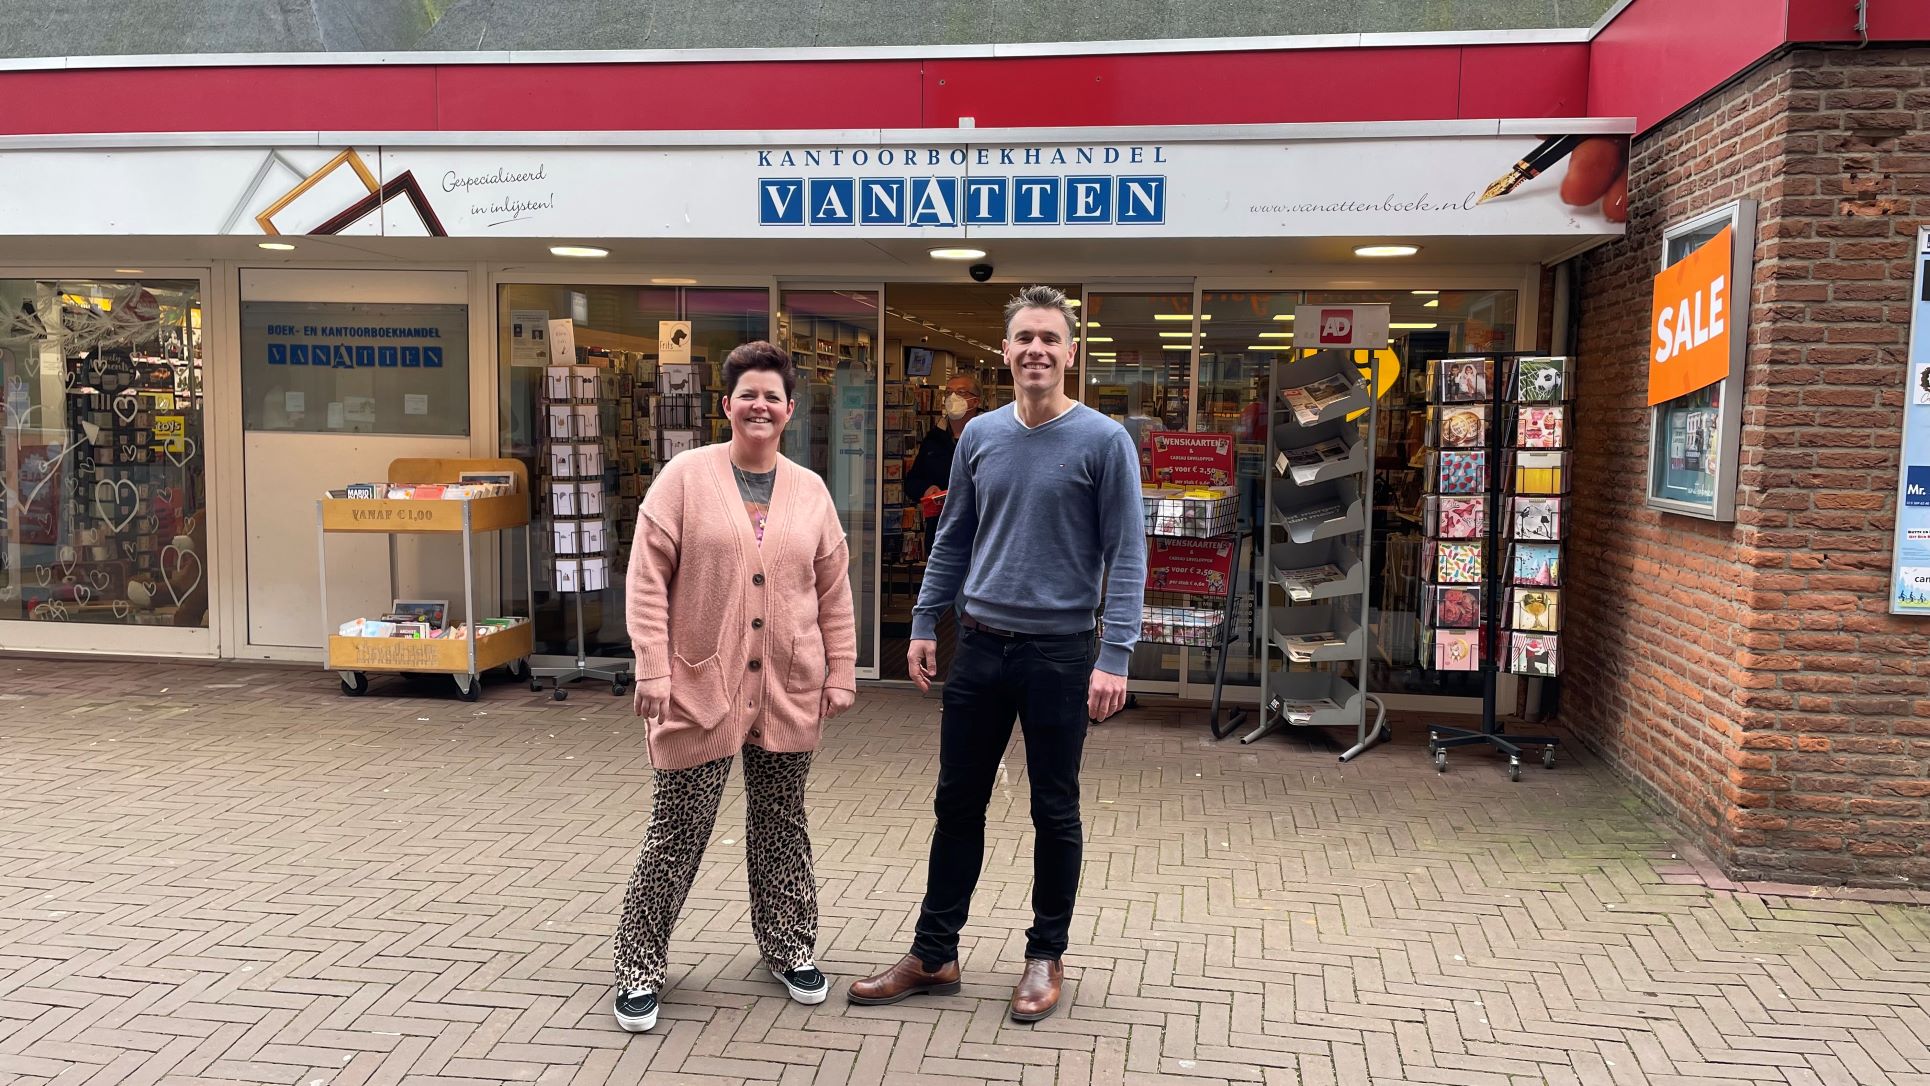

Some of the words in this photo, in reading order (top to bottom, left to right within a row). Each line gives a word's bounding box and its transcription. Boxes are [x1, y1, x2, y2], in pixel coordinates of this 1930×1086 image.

[757, 146, 1167, 167] KANTOORBOEKHANDEL
[441, 163, 547, 193] Gespecialiseerd
[471, 204, 487, 215] in
[490, 192, 554, 219] inlijsten!
[1250, 191, 1476, 213] www.vanattenboek.nl
[1321, 317, 1351, 337] AD
[1655, 275, 1725, 363] SALE
[267, 325, 300, 336] BOEK-
[303, 326, 318, 337] EN
[321, 326, 441, 338] KANTOORBOEKHANDEL
[1162, 437, 1221, 447] WENSKAARTEN
[1906, 484, 1927, 496] Mr.
[351, 509, 393, 522] VANAF
[1164, 538, 1223, 549] WENSKAARTEN
